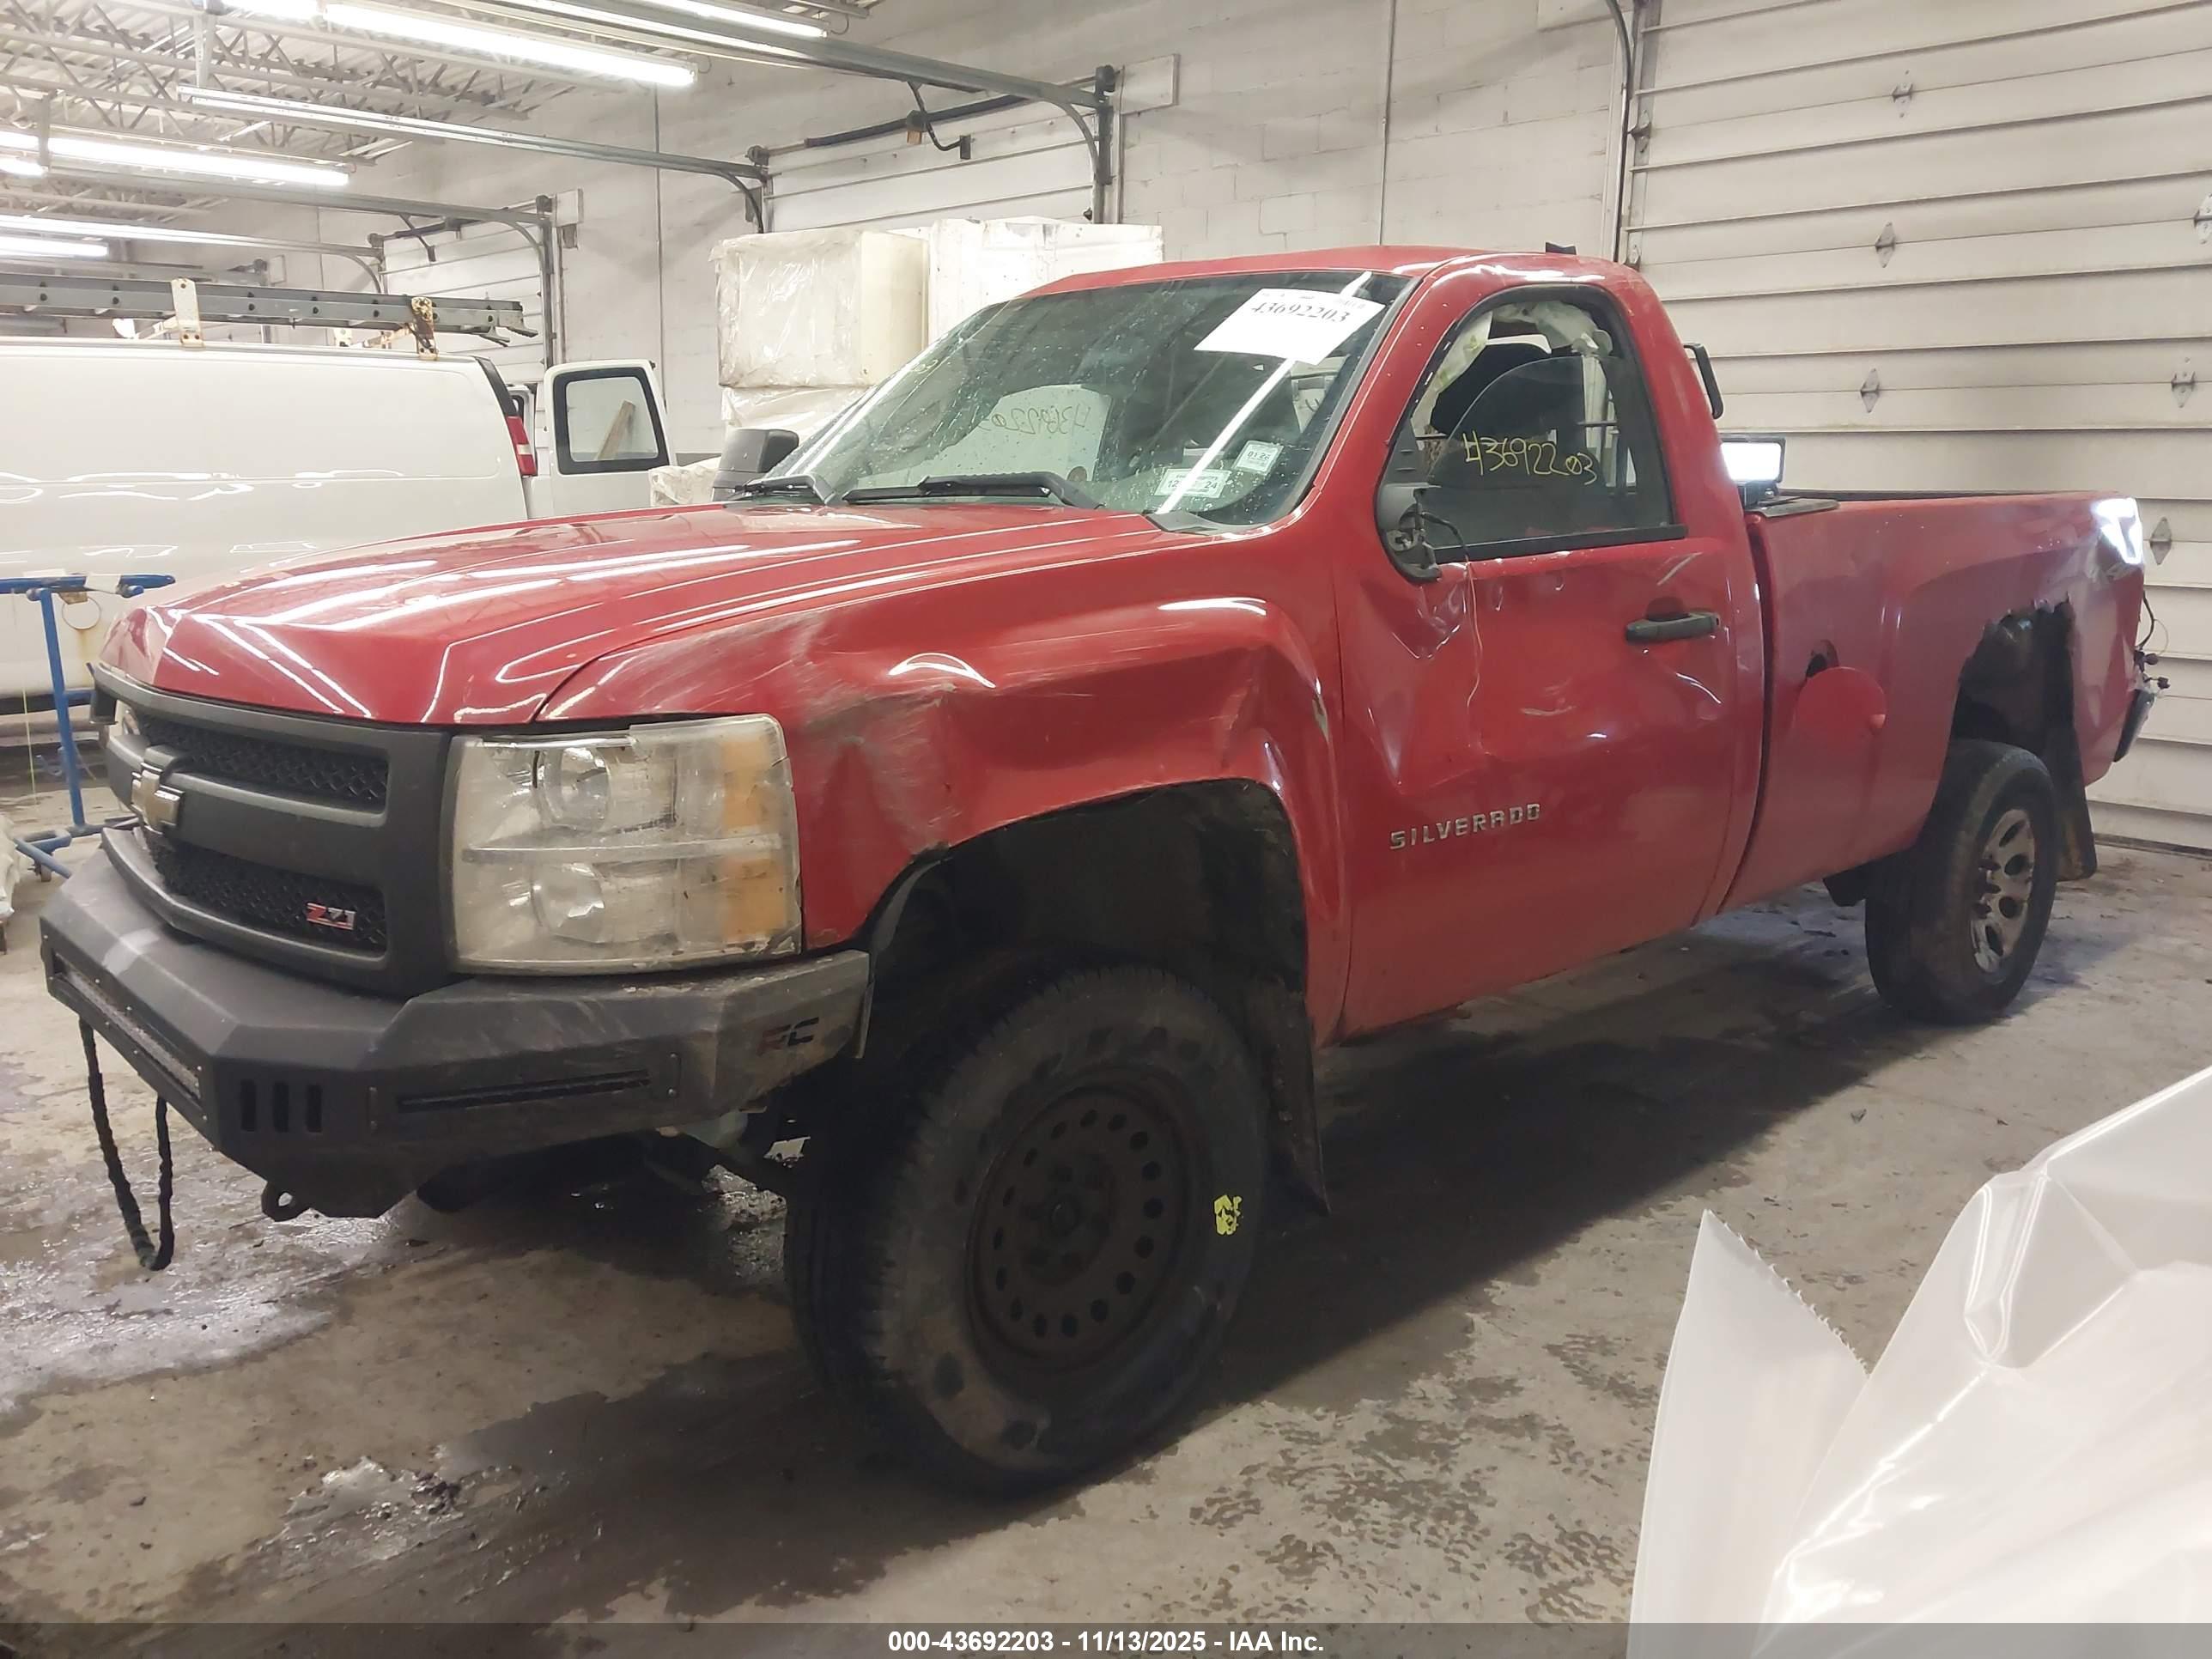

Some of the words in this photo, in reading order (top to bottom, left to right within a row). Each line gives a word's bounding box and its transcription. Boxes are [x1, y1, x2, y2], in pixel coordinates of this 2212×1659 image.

[1249, 301, 1351, 323] 43692203
[1462, 430, 1597, 485] 43692203
[1389, 803, 1540, 850] SILVERADO
[306, 902, 356, 930] Z71
